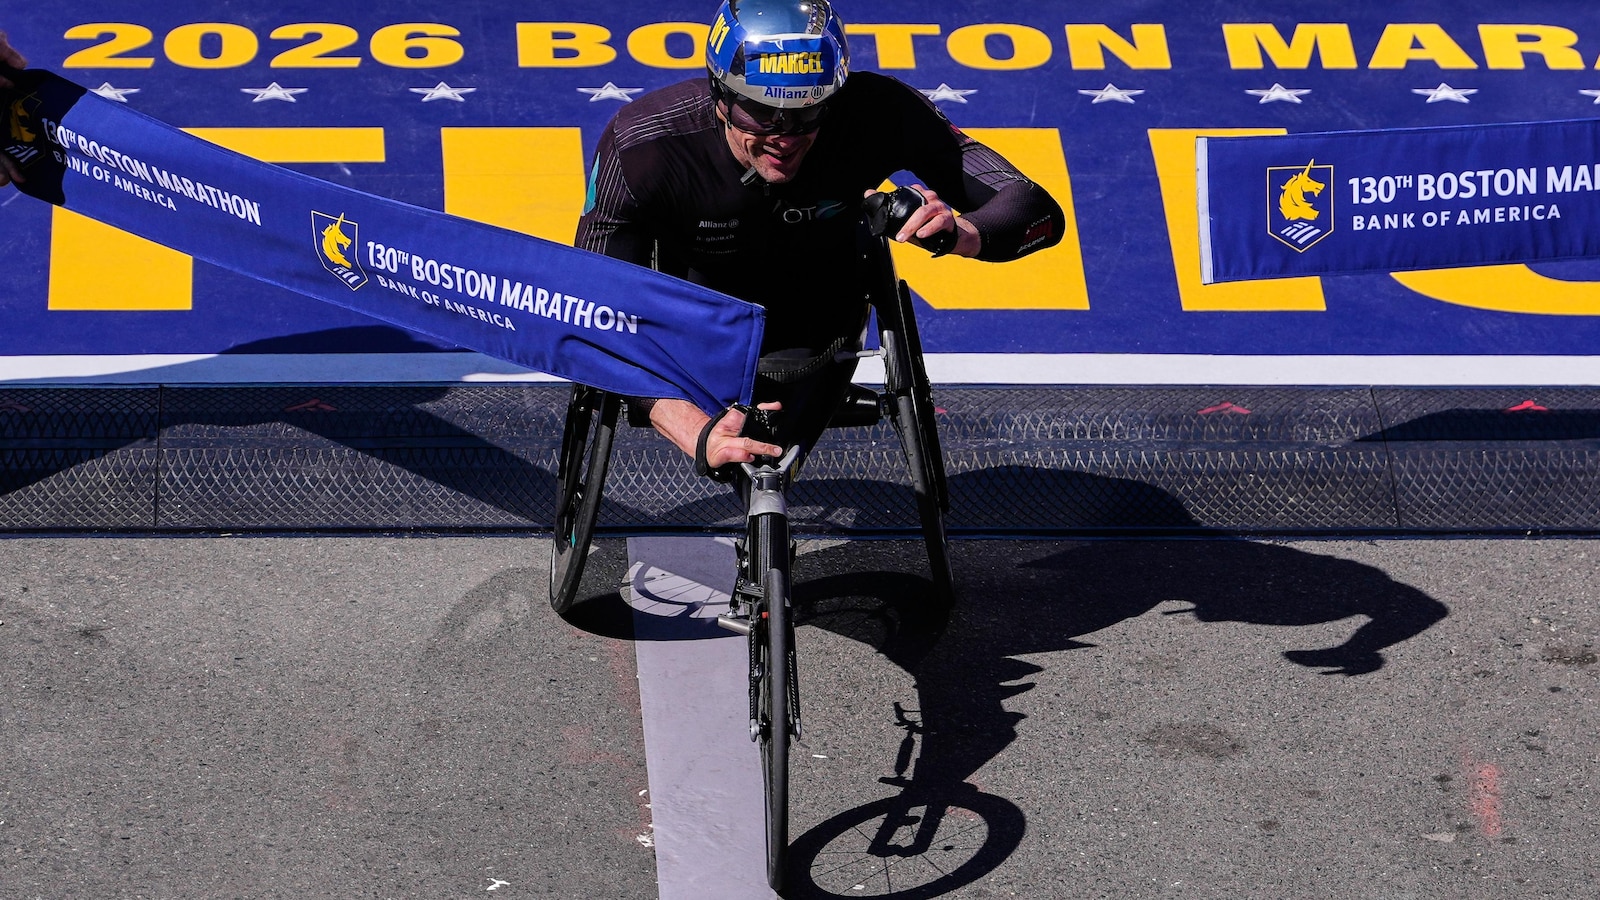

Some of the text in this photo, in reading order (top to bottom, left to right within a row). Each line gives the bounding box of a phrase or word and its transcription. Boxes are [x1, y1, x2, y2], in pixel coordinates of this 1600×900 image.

[63, 23, 1600, 70] 2026 BOTON MAR
[759, 52, 824, 74] MARCEL
[764, 86, 808, 99] Allianz
[42, 118, 262, 226] 130TH BOSTON MARATHON
[53, 150, 177, 212] BANK OF AMERICA
[1348, 174, 1413, 205] 130TH
[1417, 167, 1537, 202] BOSTON
[698, 220, 728, 228] Allianz
[1352, 204, 1561, 231] BANK OF AMERICA
[366, 241, 638, 335] 130TH BOSTON MARATHON
[376, 274, 516, 332] BANK OF AMERICA
